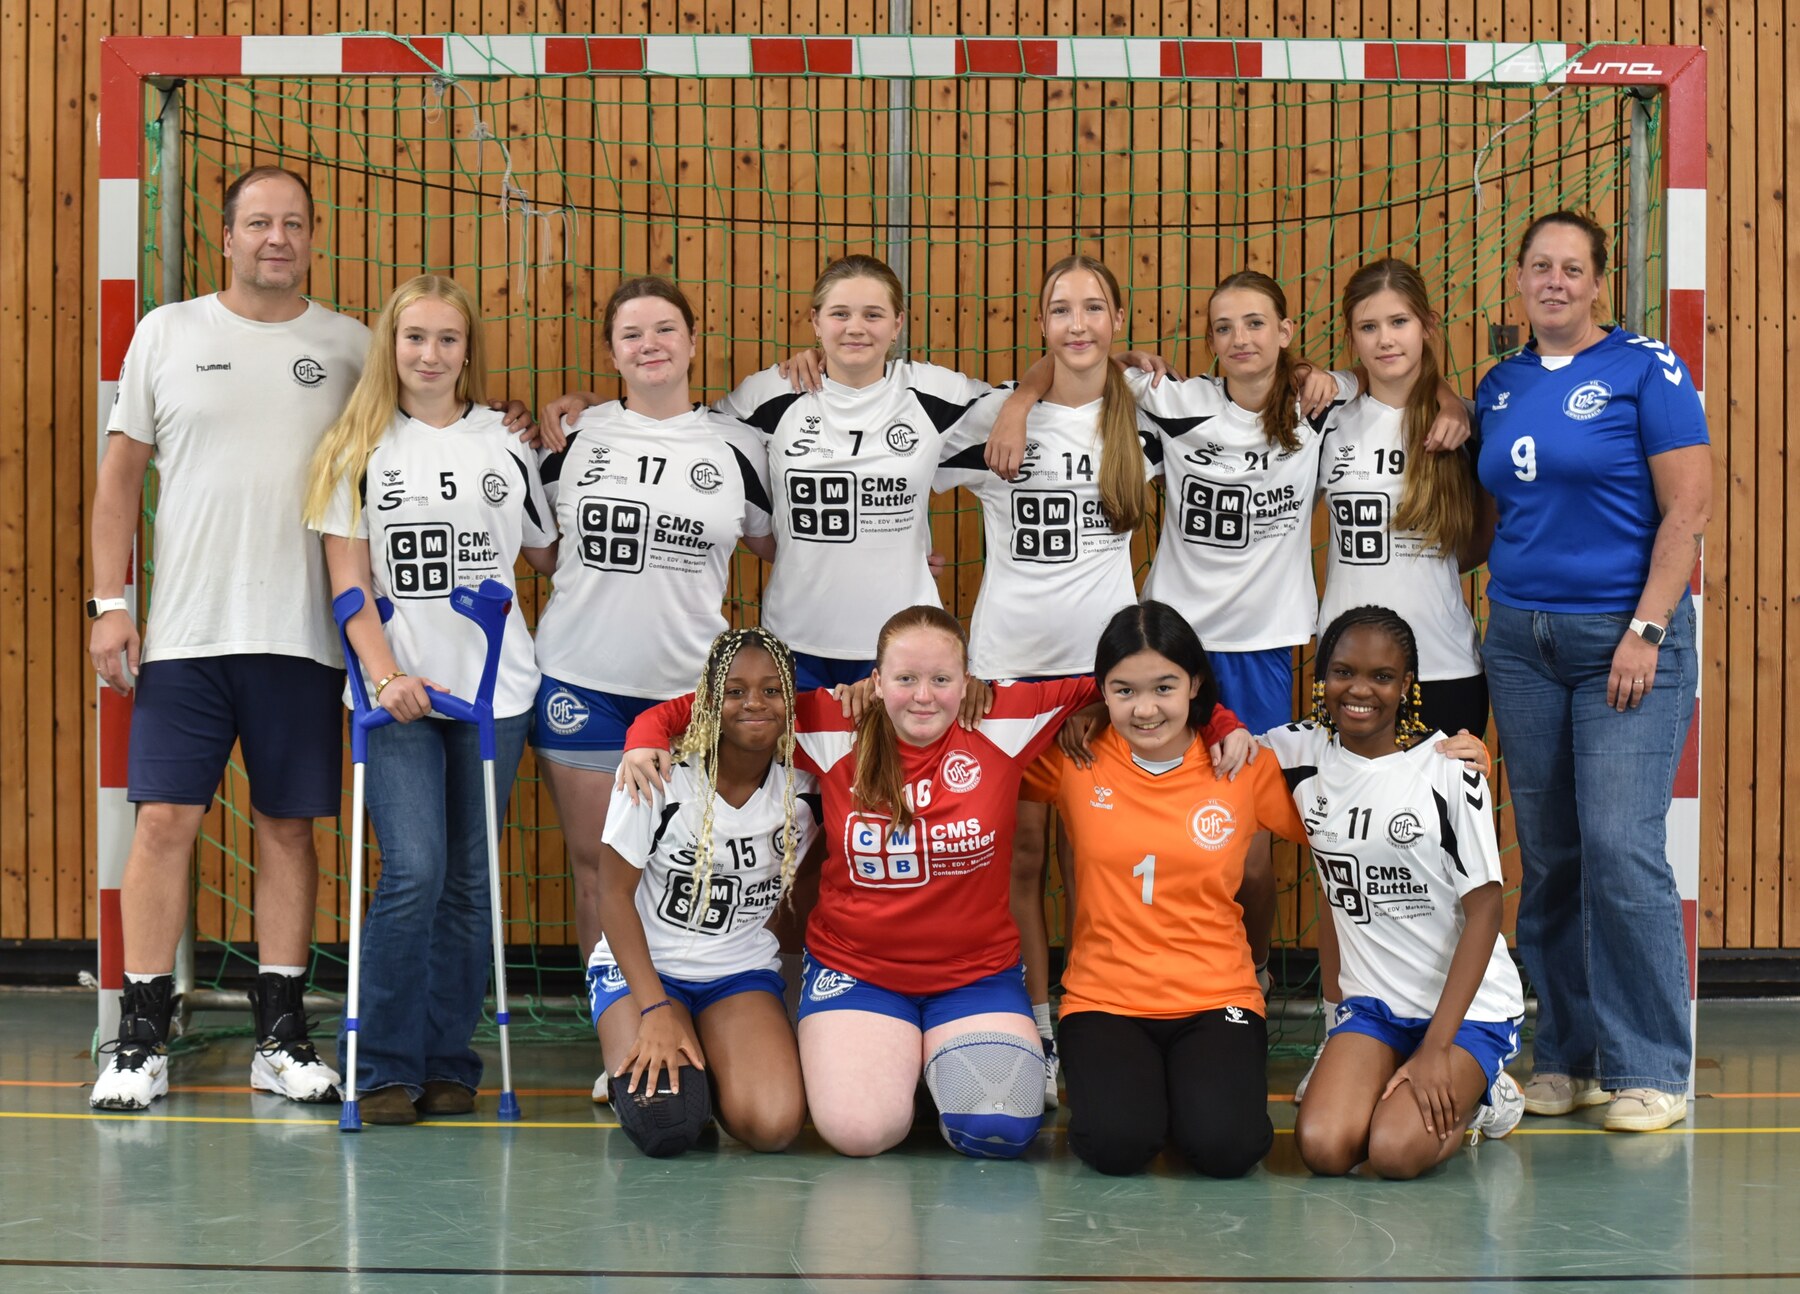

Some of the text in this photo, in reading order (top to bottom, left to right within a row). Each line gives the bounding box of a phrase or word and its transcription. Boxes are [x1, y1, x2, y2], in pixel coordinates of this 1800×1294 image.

[196, 362, 232, 372] hummel
[849, 430, 864, 456] 7
[1062, 452, 1094, 482] 14
[1244, 450, 1270, 472] 21
[1374, 448, 1405, 474] 19
[1511, 436, 1536, 482] 9
[638, 456, 667, 485] 17
[440, 472, 457, 500] 5
[862, 478, 907, 492] CMS
[1253, 485, 1294, 507] CMS
[862, 493, 918, 507] Buttler
[657, 514, 704, 536] CMS
[654, 529, 715, 550] Buttler
[1090, 800, 1114, 810] hummel
[930, 818, 981, 840] CMS
[1348, 806, 1372, 840] 11
[859, 831, 872, 846] C
[932, 830, 996, 854] Buttler
[726, 837, 757, 870] 15
[863, 860, 910, 874] S B
[1366, 866, 1412, 880] CMS
[745, 874, 782, 896] CMS
[1132, 854, 1156, 905] 1
